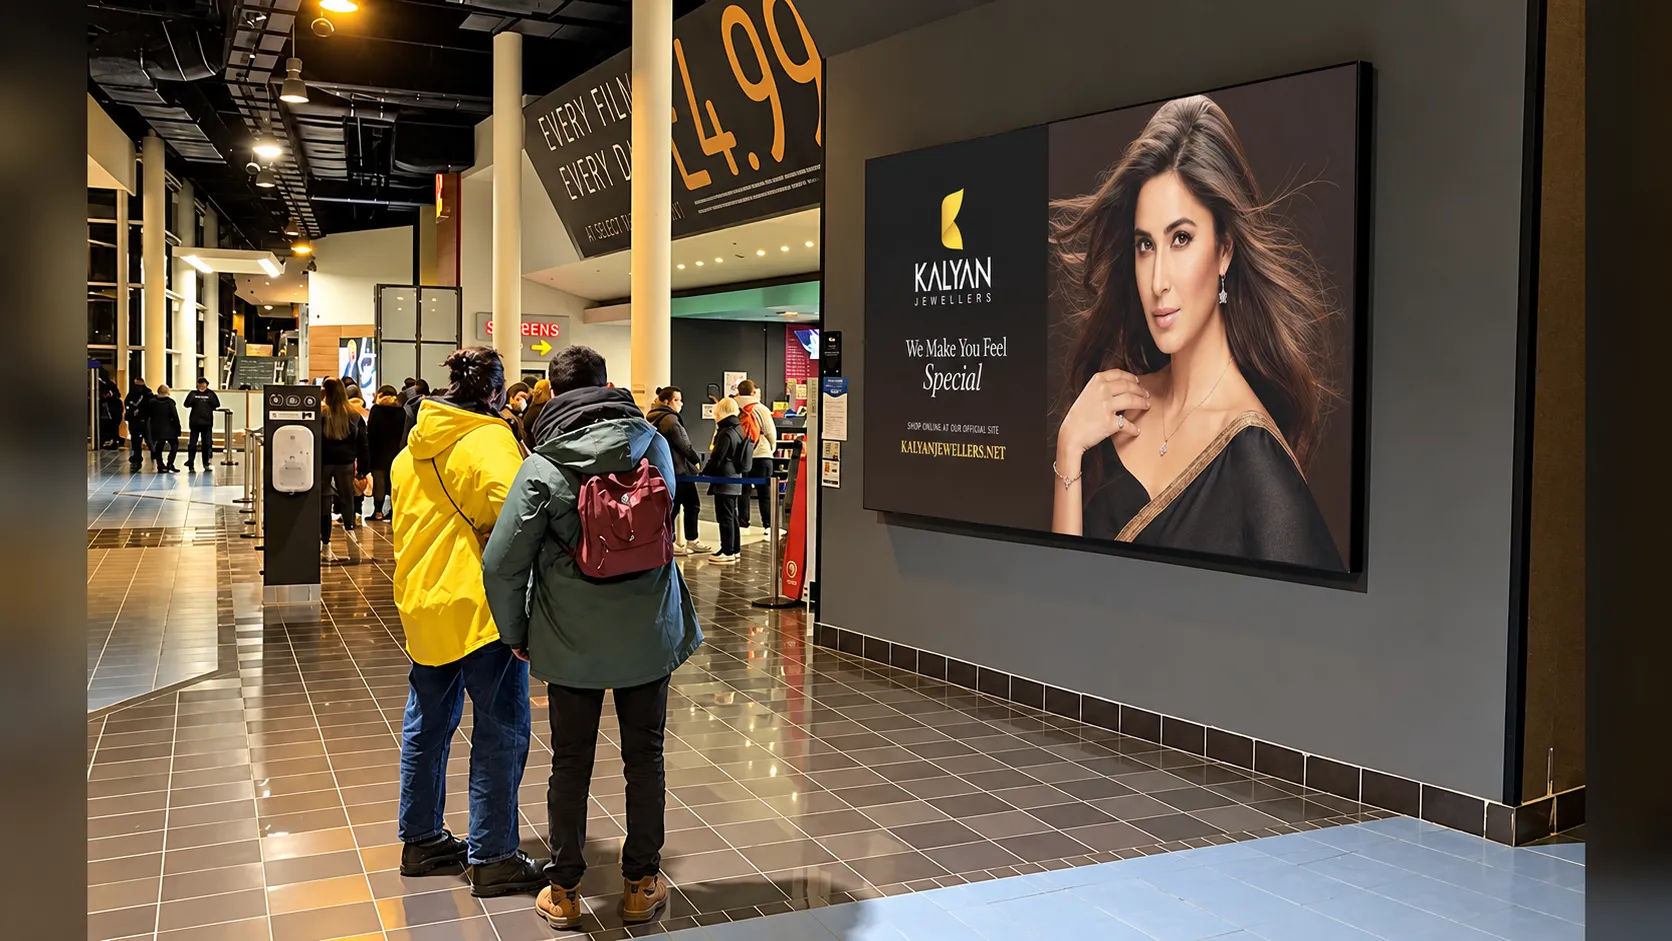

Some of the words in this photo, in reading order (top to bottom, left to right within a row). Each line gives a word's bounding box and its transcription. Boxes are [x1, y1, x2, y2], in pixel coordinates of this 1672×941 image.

[537, 95, 593, 152] EVERY
[558, 149, 614, 201] EVERY
[585, 225, 597, 243] AT
[594, 216, 623, 240] SELECT
[914, 257, 991, 293] KALYAN
[914, 292, 992, 307] JEWELLERS
[487, 320, 560, 337] SEENS
[906, 339, 924, 358] We
[926, 337, 957, 358] Make
[958, 337, 981, 358] You
[982, 336, 1008, 357] Feel
[922, 363, 983, 398] Special
[907, 421, 921, 431] SHOP
[922, 422, 942, 432] ONLINE
[943, 423, 949, 432] AT
[950, 424, 961, 433] OUR
[962, 424, 986, 434] OFFICIAL
[987, 425, 999, 435] SITE
[901, 440, 1007, 460] KALYANJEWELLERS.NET
